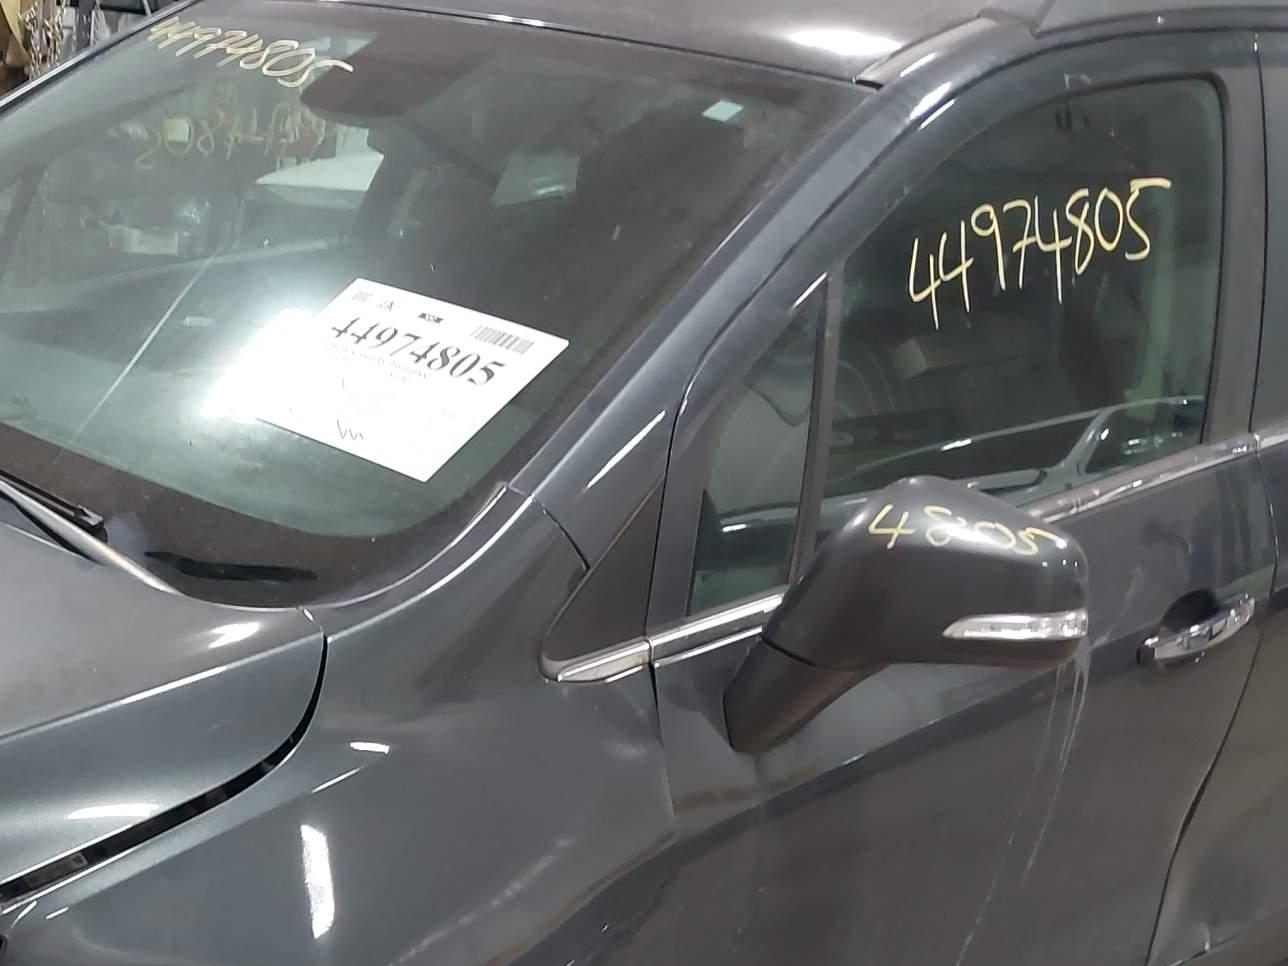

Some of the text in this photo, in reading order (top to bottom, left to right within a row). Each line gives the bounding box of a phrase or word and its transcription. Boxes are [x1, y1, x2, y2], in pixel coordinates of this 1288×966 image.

[908, 177, 1172, 330] 44974805
[330, 317, 507, 385] 44974805
[868, 503, 1068, 557] 4805
